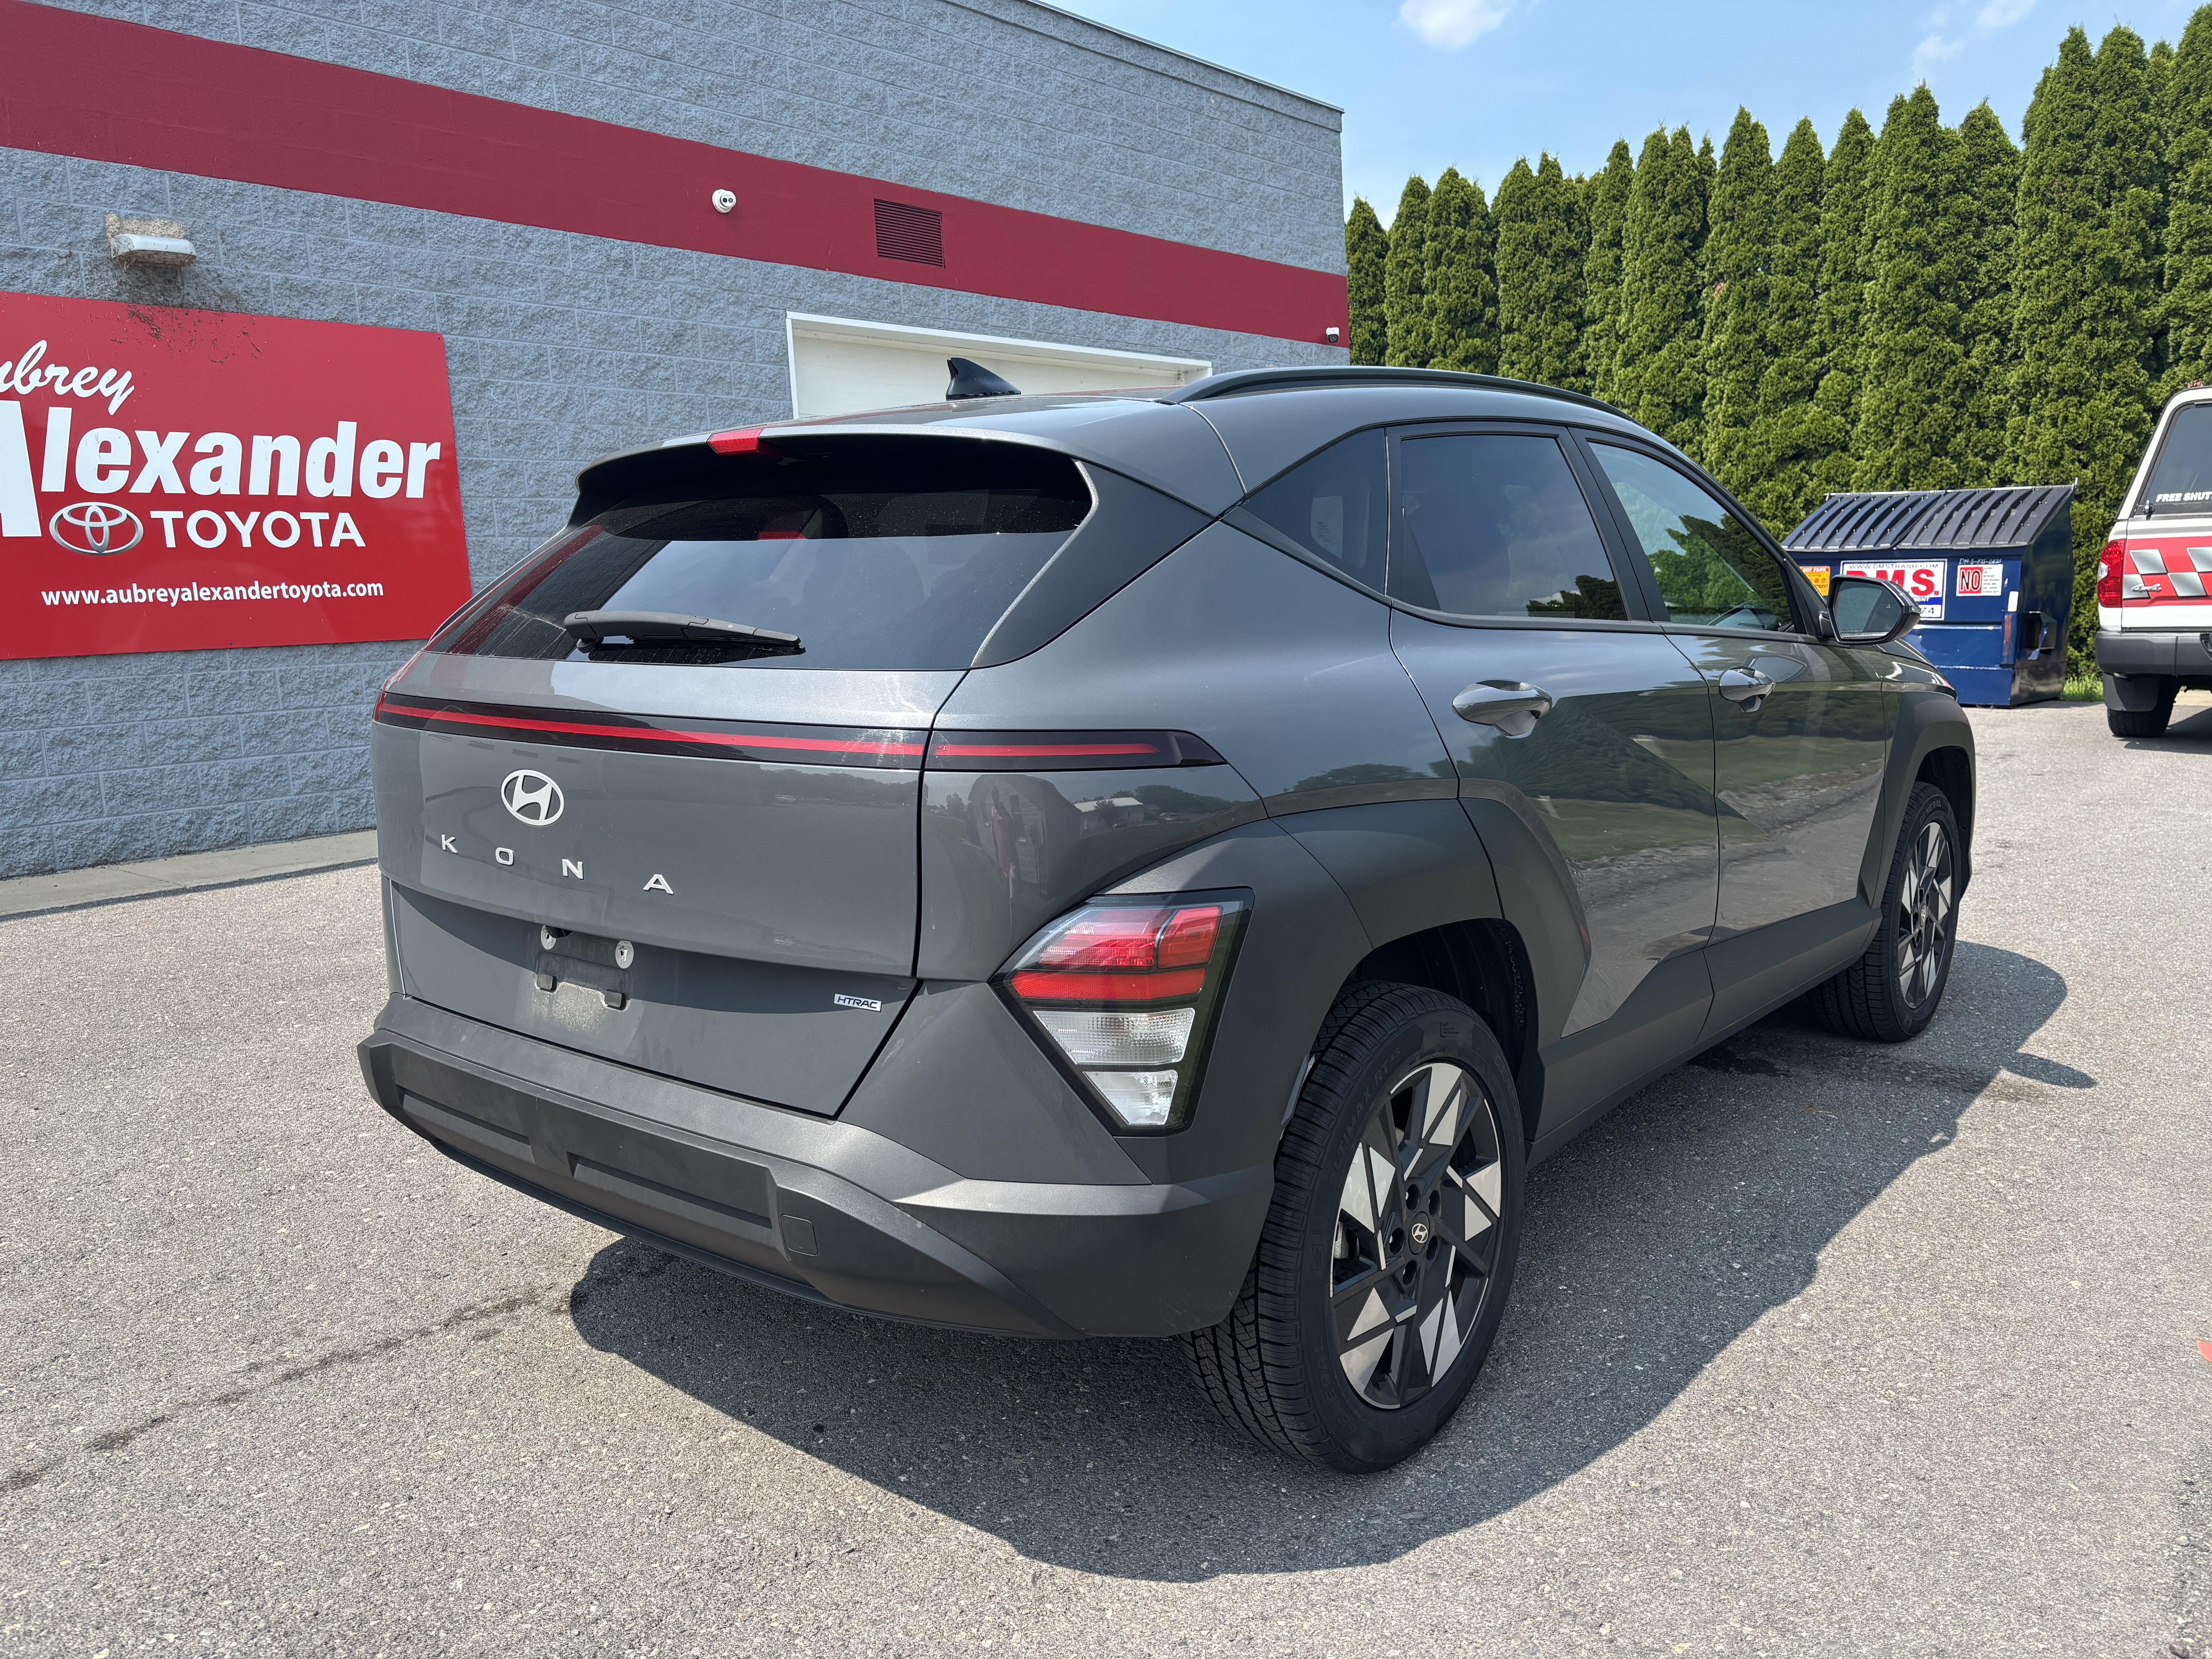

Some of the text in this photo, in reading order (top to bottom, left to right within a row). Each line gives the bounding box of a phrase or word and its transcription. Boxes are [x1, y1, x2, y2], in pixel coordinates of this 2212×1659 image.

[0, 340, 135, 416] brey
[2156, 491, 2212, 502] FREE SHUT
[150, 510, 366, 548] TOYOTA
[41, 580, 383, 607] www.aubreyalexandertoyota.com
[1960, 569, 1982, 592] NO
[441, 834, 674, 894] KONA
[837, 996, 878, 1009] HTRAC
